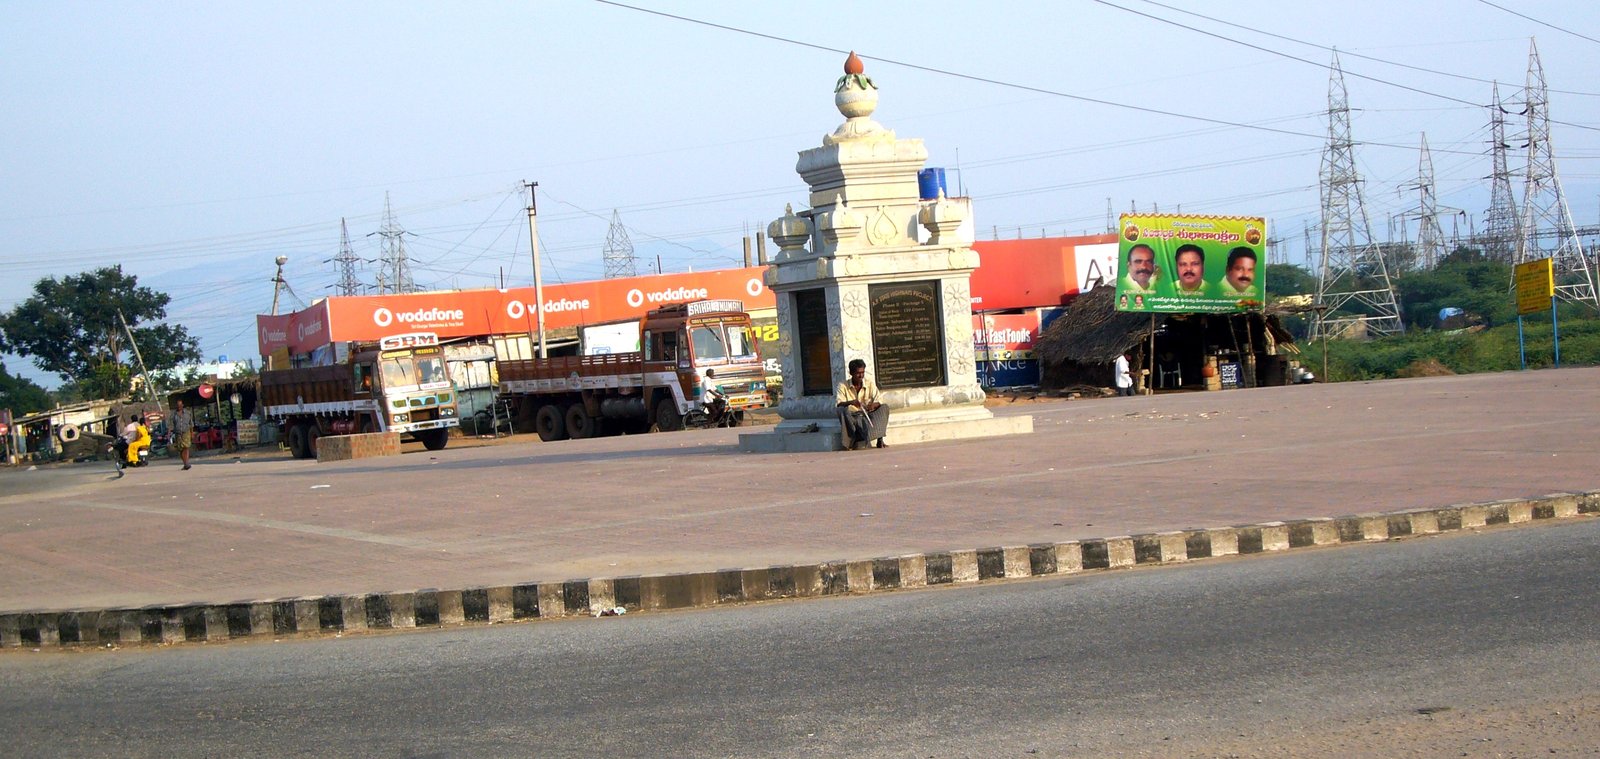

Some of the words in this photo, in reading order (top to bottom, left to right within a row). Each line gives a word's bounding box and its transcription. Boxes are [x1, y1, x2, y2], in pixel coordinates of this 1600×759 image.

[1084, 256, 1119, 289] Ai
[647, 287, 707, 302] vodafone
[527, 298, 590, 314] vdafone
[396, 308, 463, 323] vodafone
[304, 320, 322, 335] vodafone
[268, 330, 286, 342] vodafone
[990, 330, 1006, 343] Fast
[1007, 328, 1031, 343] Foods
